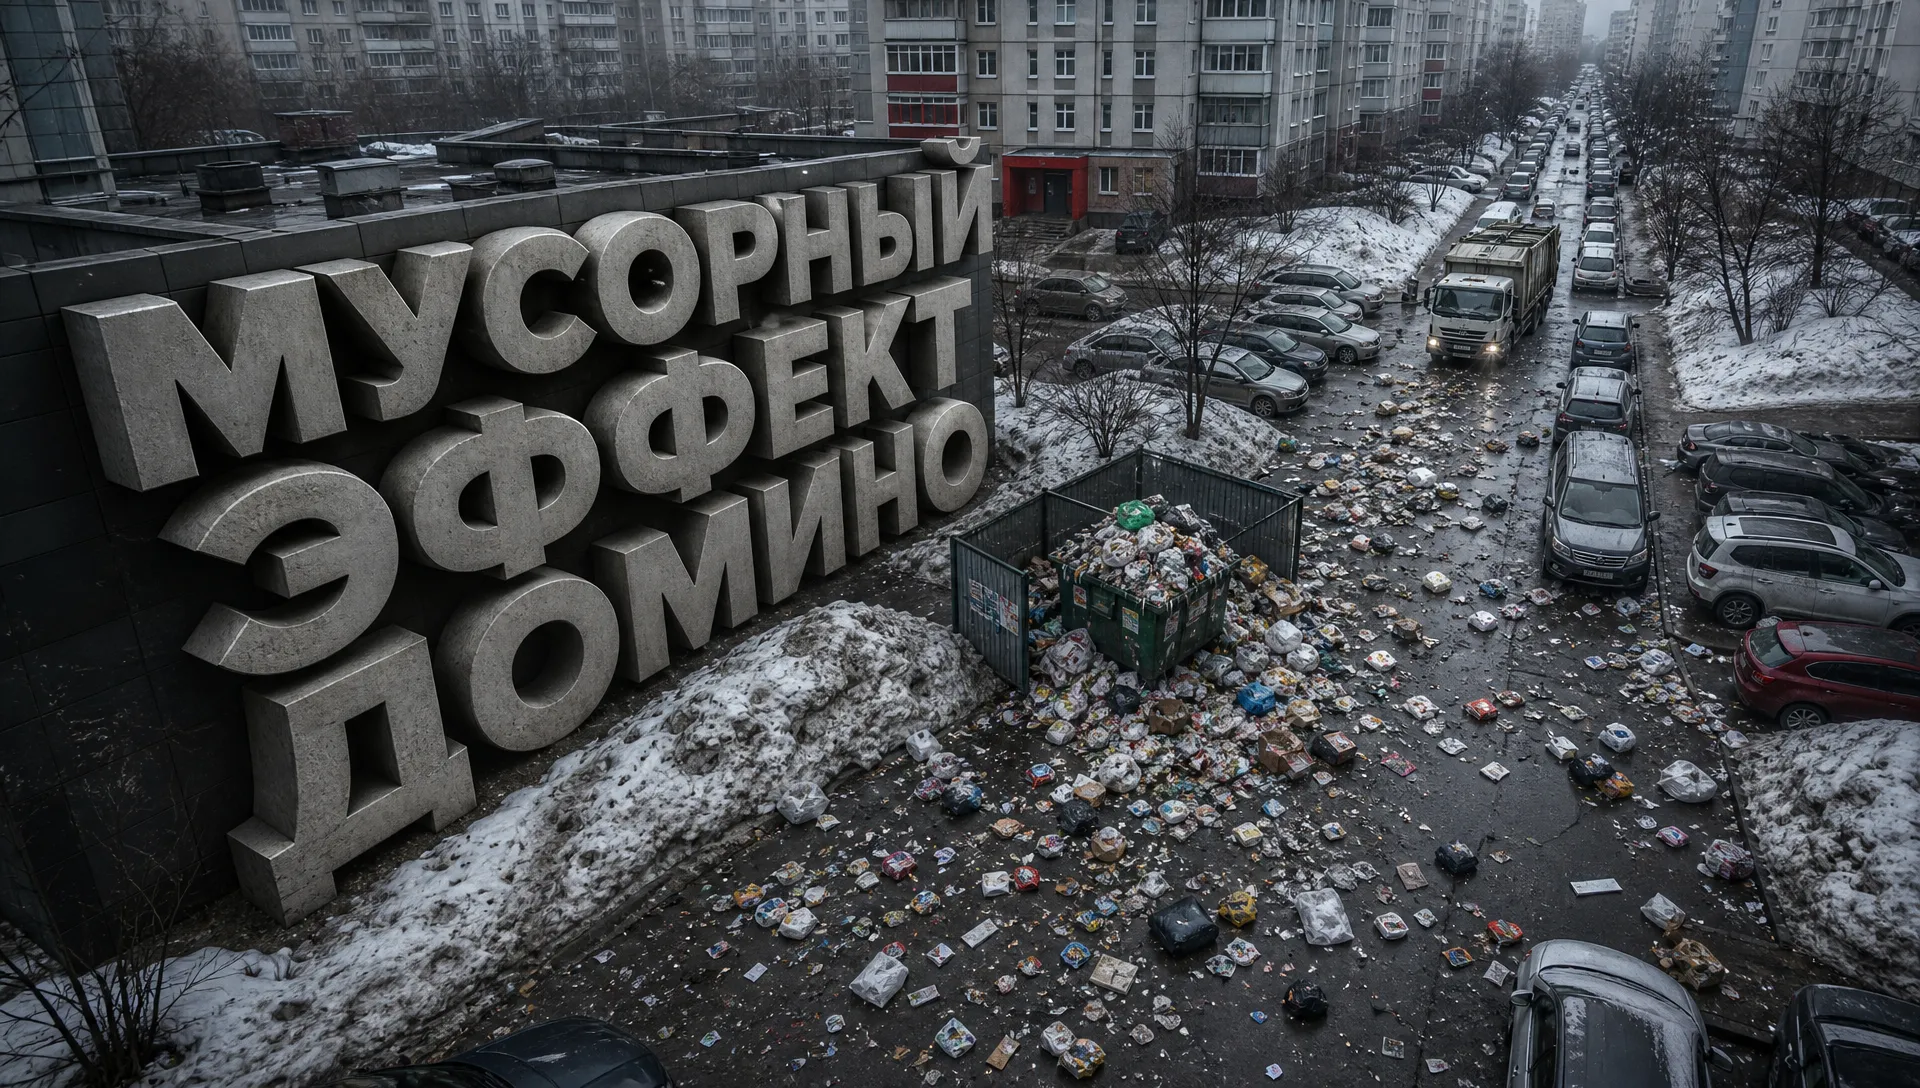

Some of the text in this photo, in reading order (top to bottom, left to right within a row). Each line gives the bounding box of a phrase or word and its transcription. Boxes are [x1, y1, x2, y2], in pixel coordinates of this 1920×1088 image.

[61, 136, 993, 492] МУСОРНЫЙ
[157, 275, 972, 676] ЭФФЕКТ
[227, 397, 989, 928] ДОМИНО
